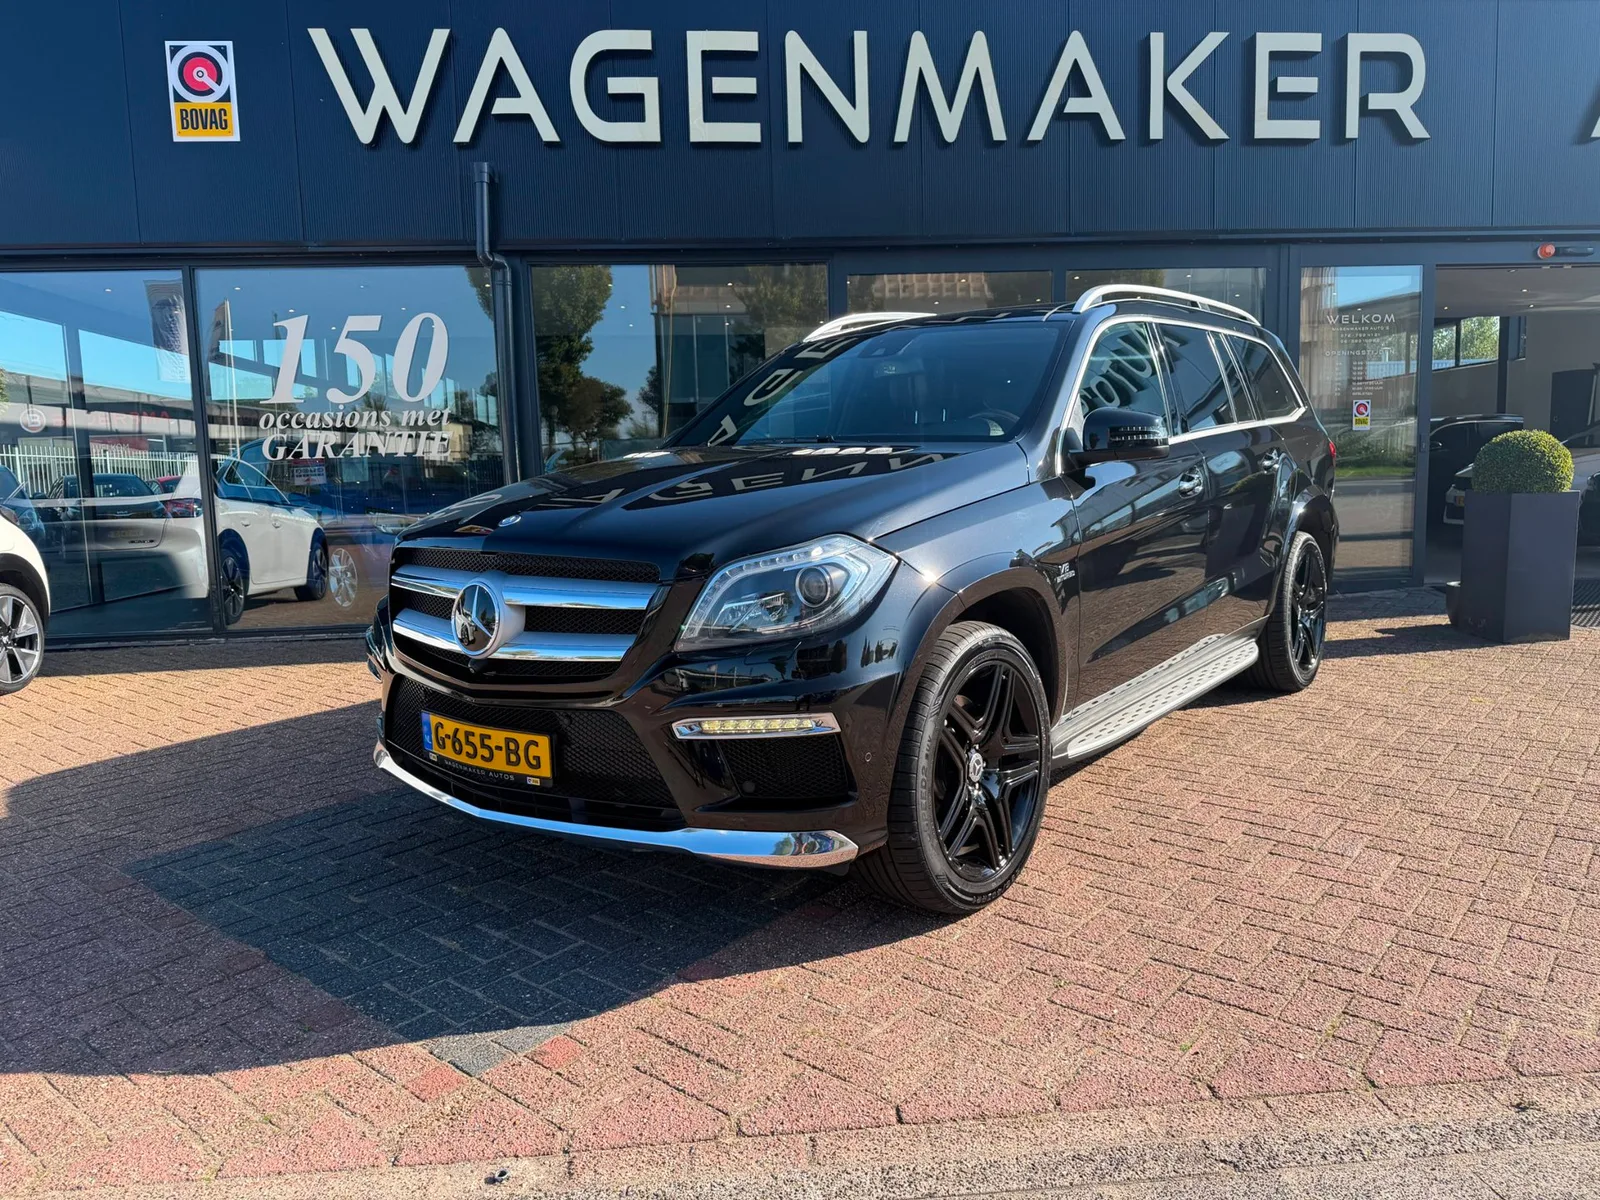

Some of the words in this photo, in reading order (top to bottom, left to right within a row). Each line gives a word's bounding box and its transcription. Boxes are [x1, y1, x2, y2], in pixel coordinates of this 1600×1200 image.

[307, 27, 1431, 145] WAGENMAKER
[180, 109, 228, 130] BOVAG
[1326, 314, 1395, 325] WELKOM
[259, 312, 449, 405] 150
[259, 404, 392, 430] occasions
[400, 406, 452, 427] met
[262, 430, 452, 461] GARANTIE
[434, 721, 541, 770] G-655-BG
[445, 760, 486, 775] WAGENMAKER
[488, 772, 515, 781] AUTOS
